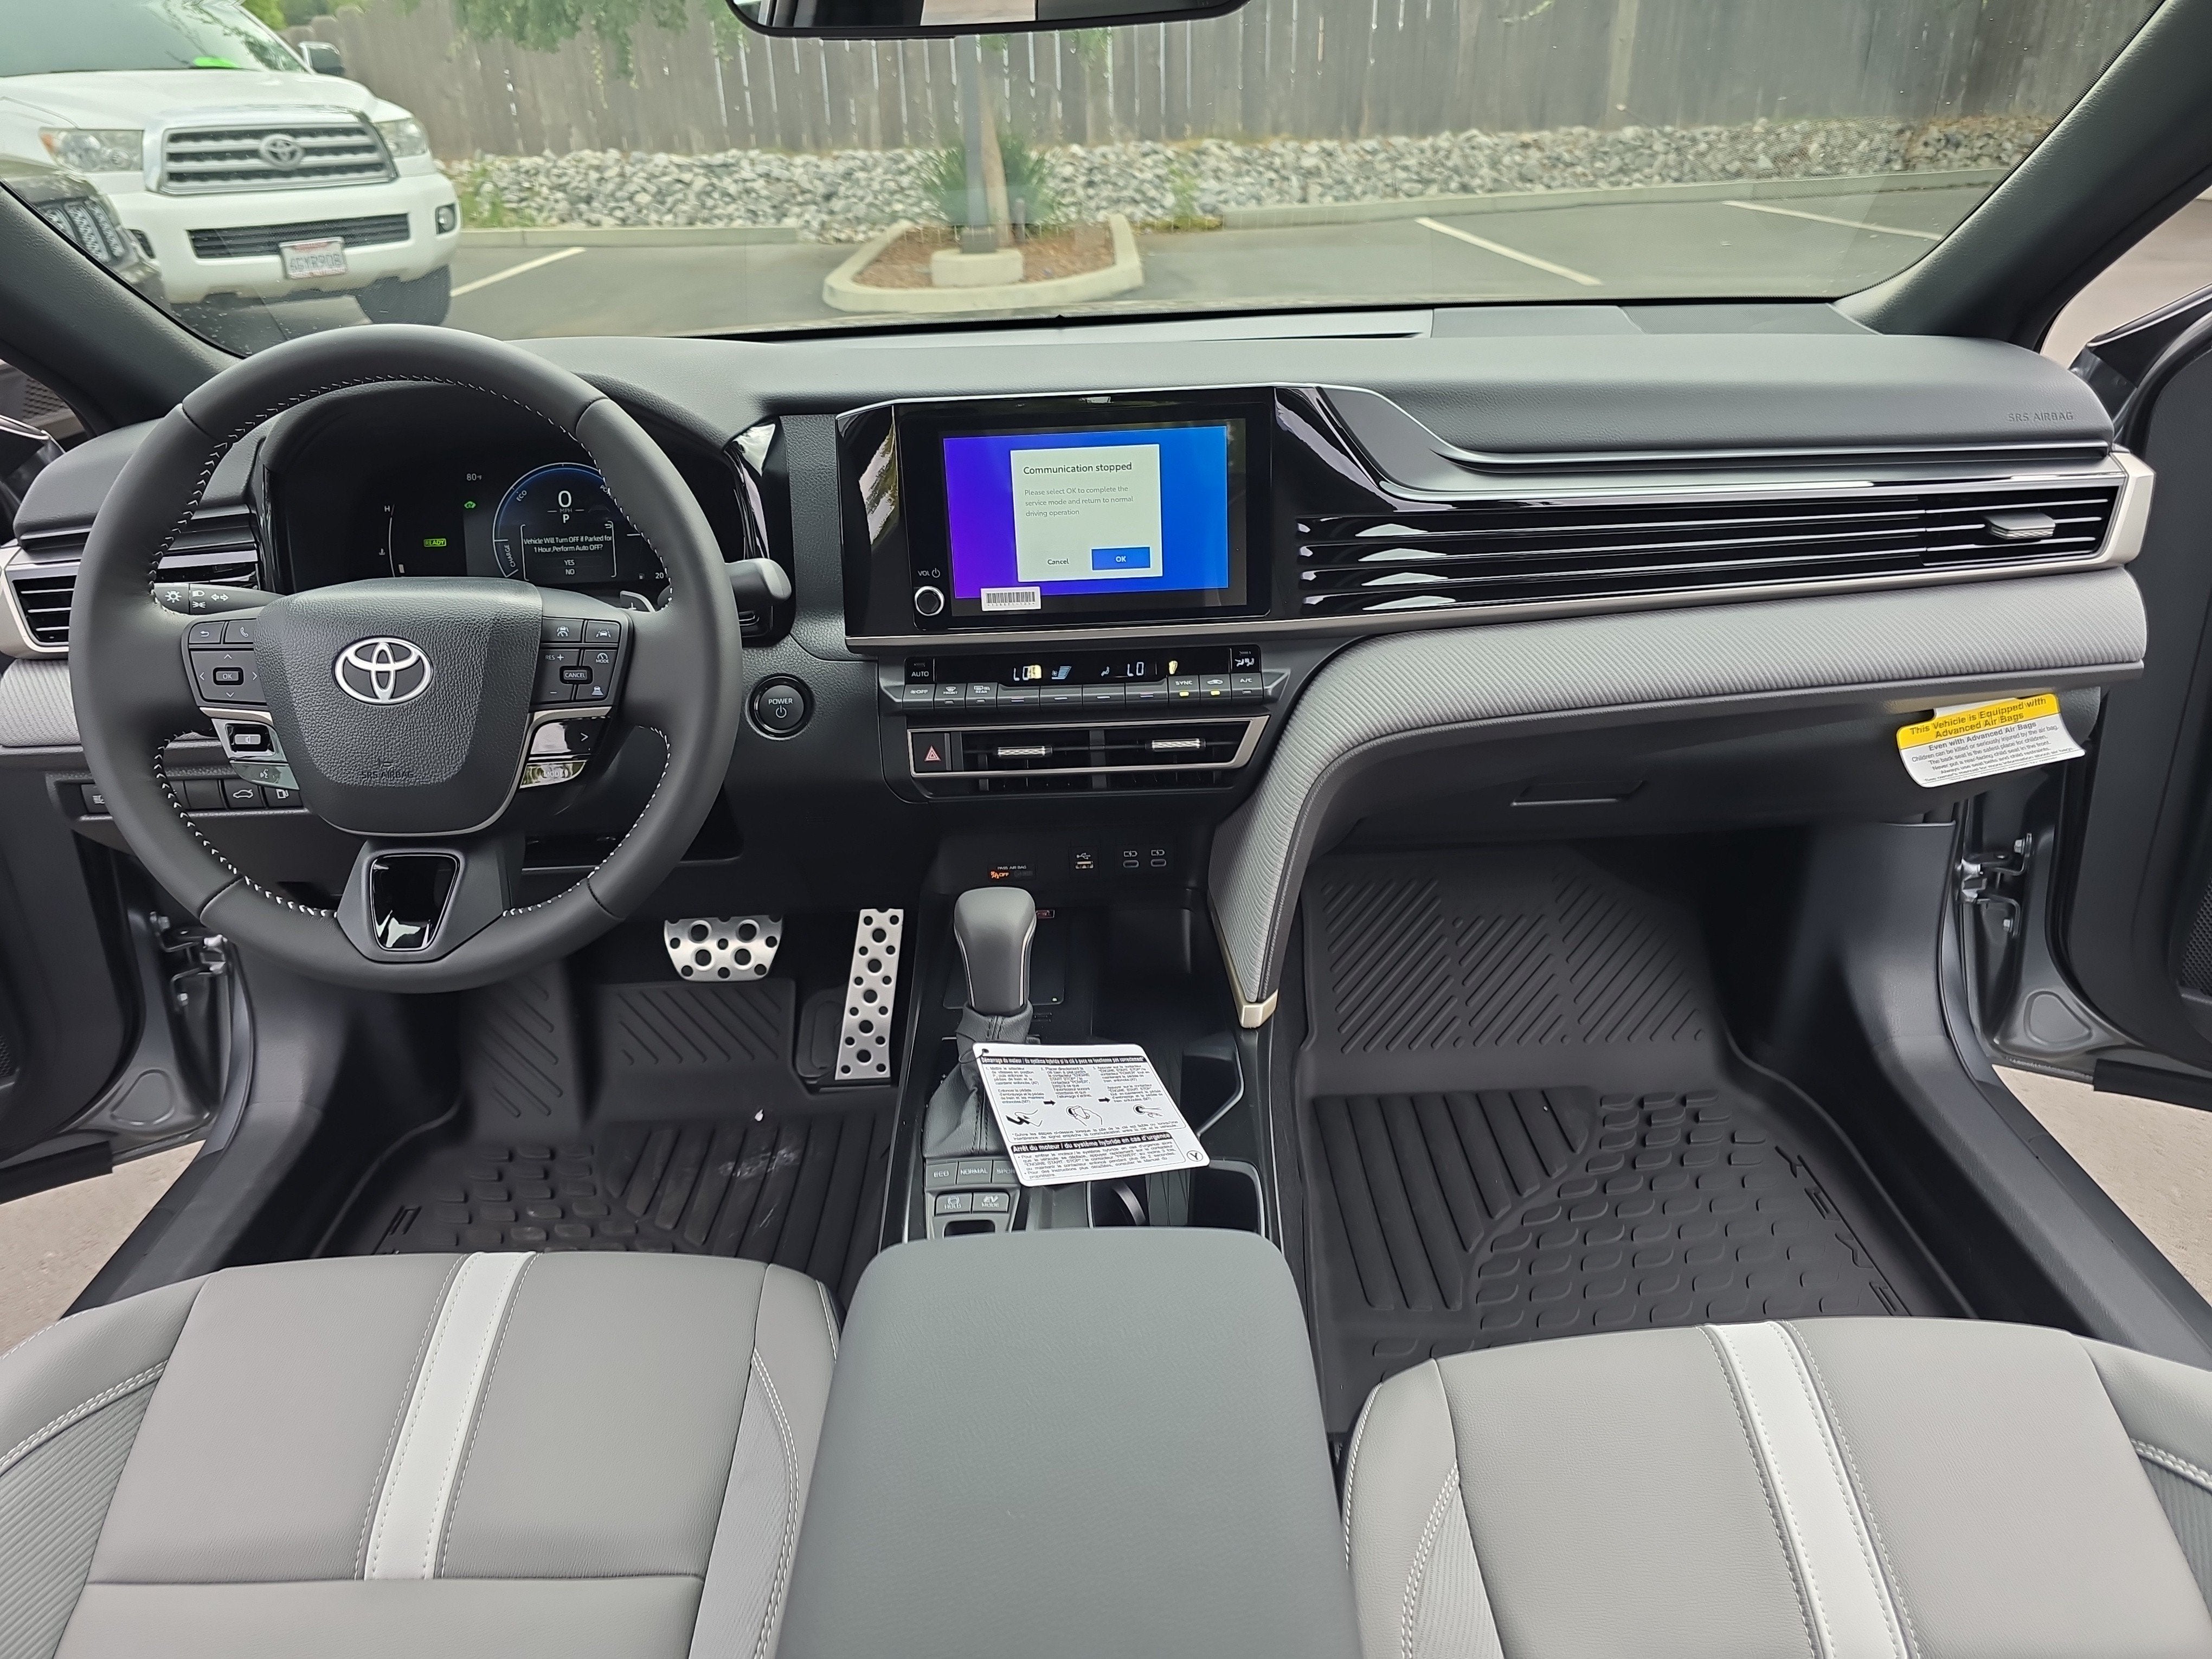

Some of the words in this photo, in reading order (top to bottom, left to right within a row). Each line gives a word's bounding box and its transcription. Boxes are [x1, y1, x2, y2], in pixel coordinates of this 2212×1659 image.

[2008, 413, 2029, 422] SRS
[2033, 411, 2073, 421] AIRBAG
[1023, 464, 1094, 474] Communication
[1095, 462, 1132, 473] stopped
[516, 490, 527, 502] ECO
[558, 490, 572, 507] 0
[1049, 509, 1079, 517] operation
[563, 514, 570, 524] P
[504, 544, 516, 568] CHARGE
[1115, 555, 1127, 563] OK
[1909, 724, 1930, 735] This
[1932, 716, 1966, 730] Vehicle
[1969, 713, 1977, 721] is
[1979, 702, 2024, 720] Equipped
[2027, 697, 2046, 708] with
[1935, 723, 1981, 738] Advanced
[1984, 718, 1997, 728] Air
[2000, 712, 2024, 723] Bags
[1928, 743, 1947, 751] Even
[1949, 738, 1965, 746] with
[1966, 729, 2003, 742] Advanced
[2017, 722, 2036, 731] Bags
[1912, 754, 1935, 762] Children
[1953, 744, 1969, 753] killed
[1976, 738, 2000, 748] seriously
[2001, 732, 2020, 742] injured
[1983, 745, 2000, 753] safest
[2024, 735, 2048, 743] children.
[2023, 747, 2050, 755] restraints.
[1964, 754, 1994, 763] rear-facing
[380, 770, 414, 780] AIRBAG
[1189, 1152, 1198, 1161] Y
[933, 1170, 949, 1178] ECO
